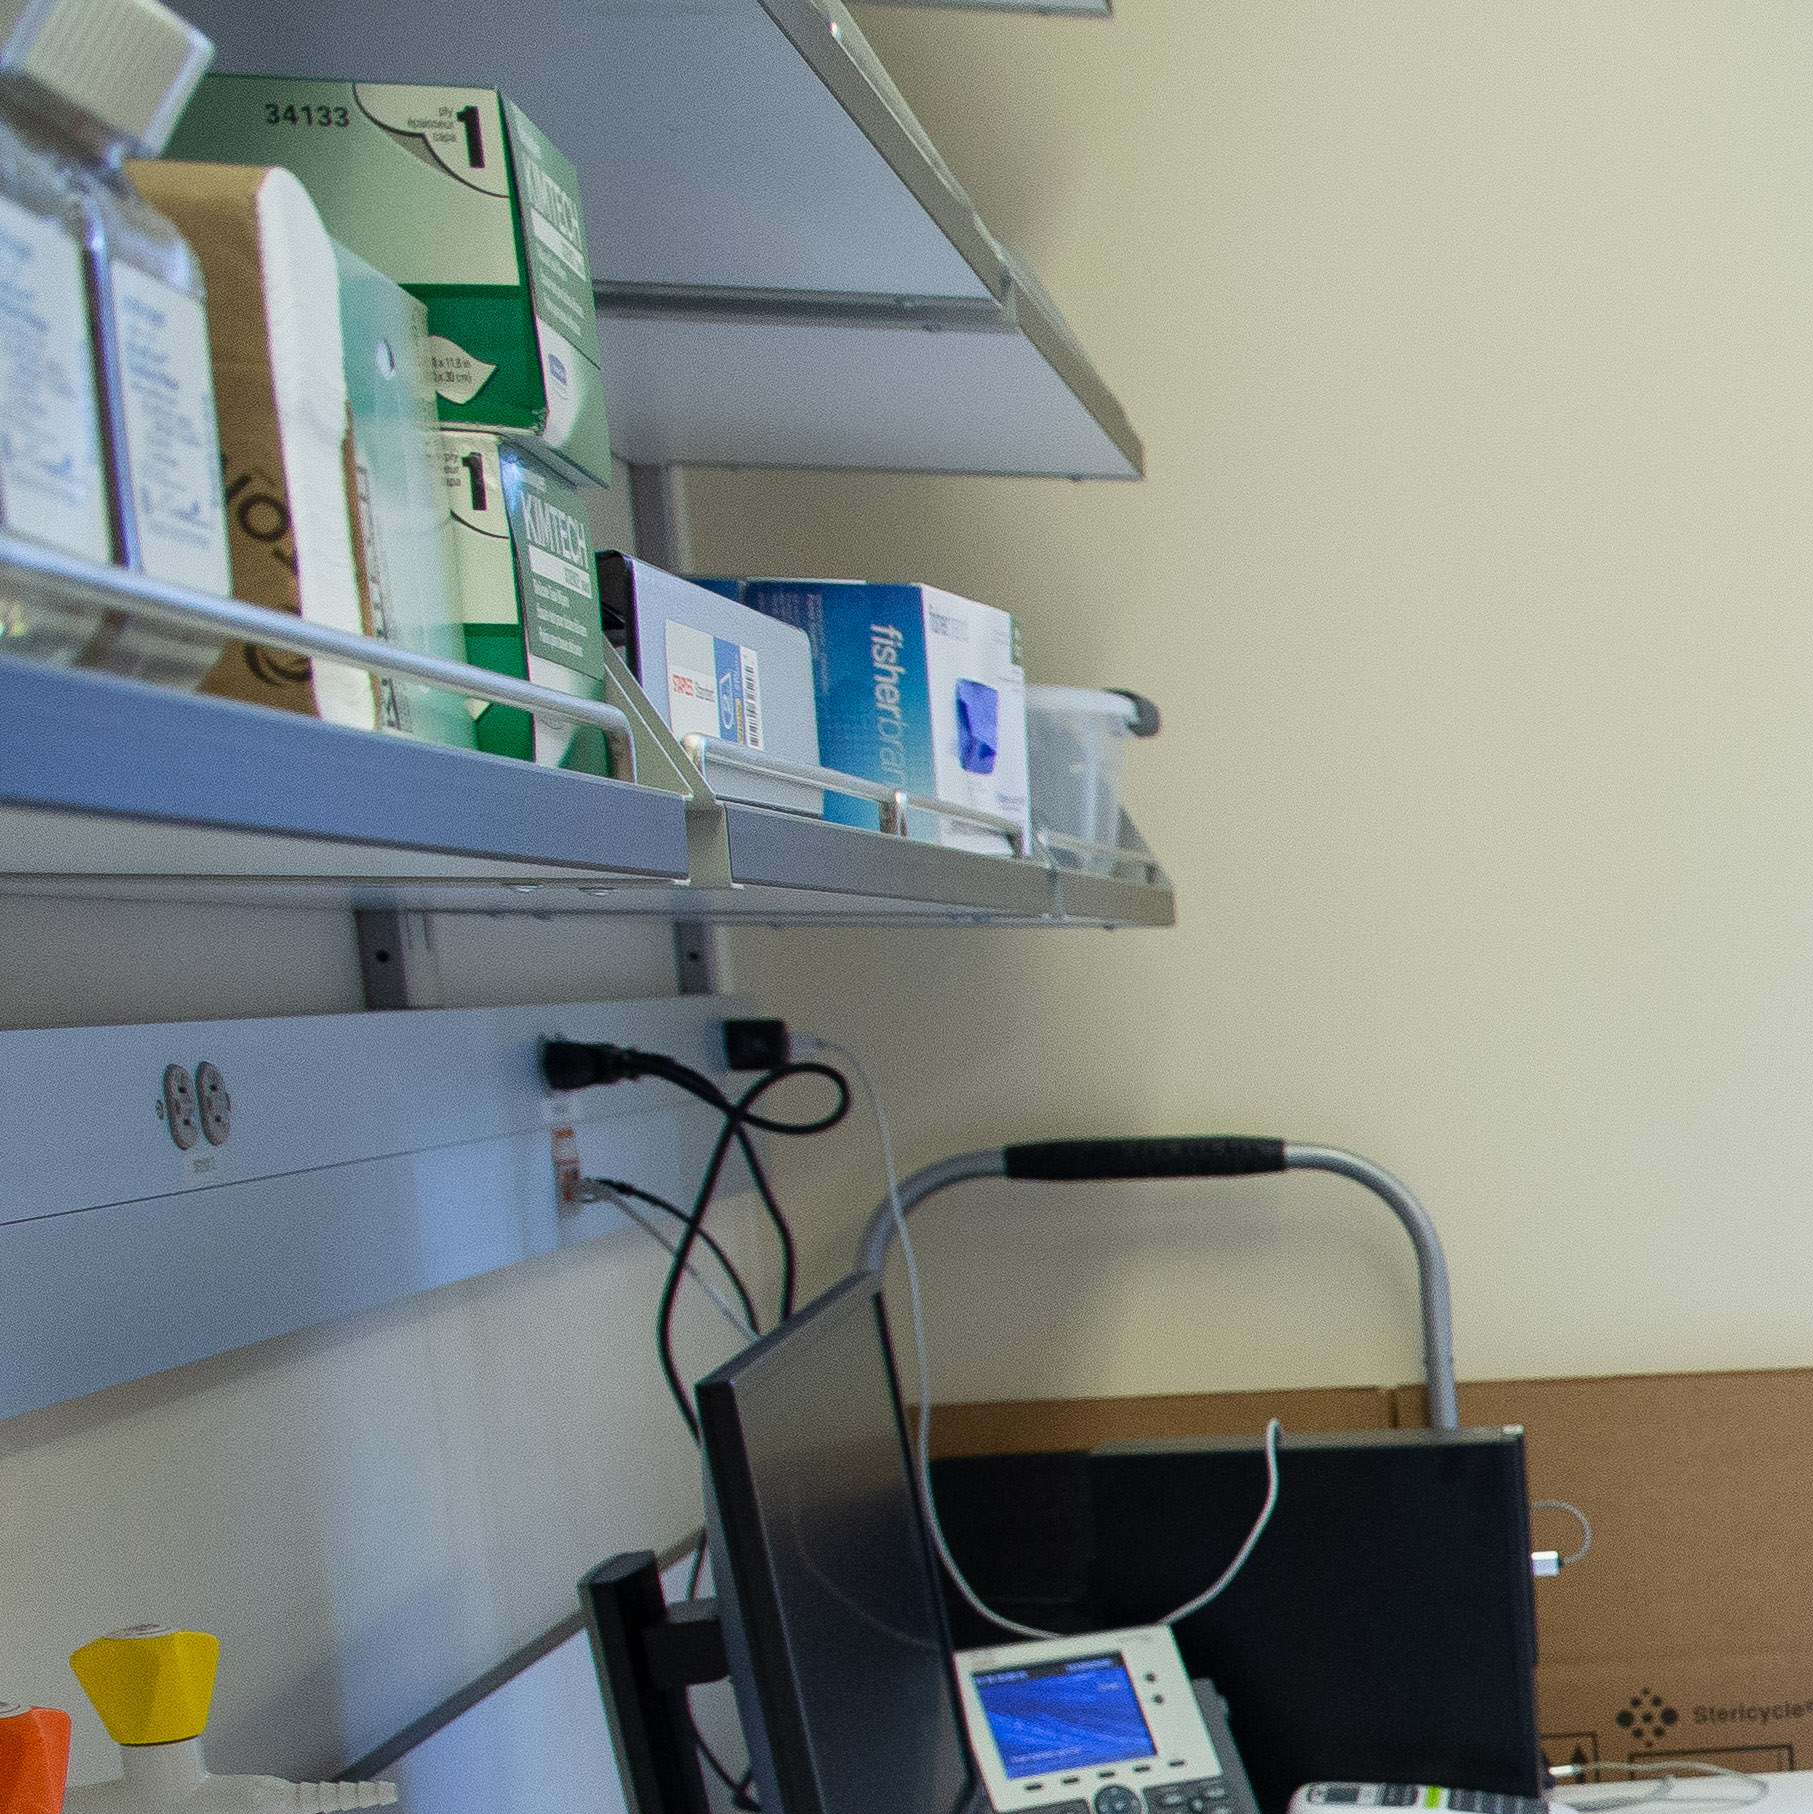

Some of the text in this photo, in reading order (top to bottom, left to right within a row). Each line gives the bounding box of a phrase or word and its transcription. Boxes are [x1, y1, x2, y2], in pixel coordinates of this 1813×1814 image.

[264, 103, 350, 127] 34133
[456, 105, 486, 169] 1
[461, 452, 488, 511] 1
[520, 490, 590, 570] KIMTECH
[869, 623, 908, 788] fisherbran
